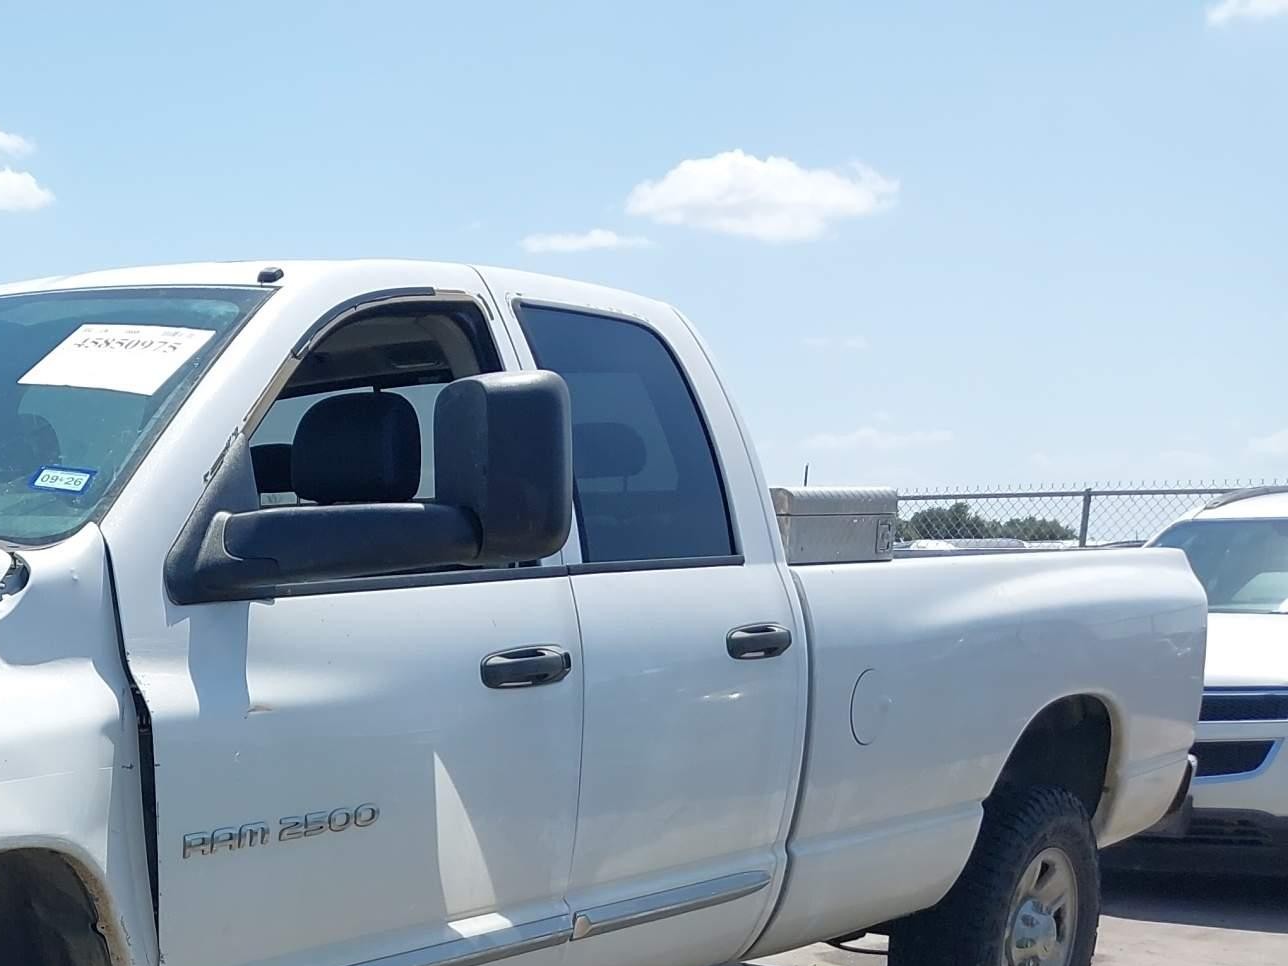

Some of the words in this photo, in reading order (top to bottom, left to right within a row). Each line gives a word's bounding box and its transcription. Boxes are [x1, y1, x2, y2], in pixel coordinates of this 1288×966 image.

[73, 336, 183, 353] 45850975
[182, 821, 271, 860] RAM
[278, 802, 381, 842] 2500
